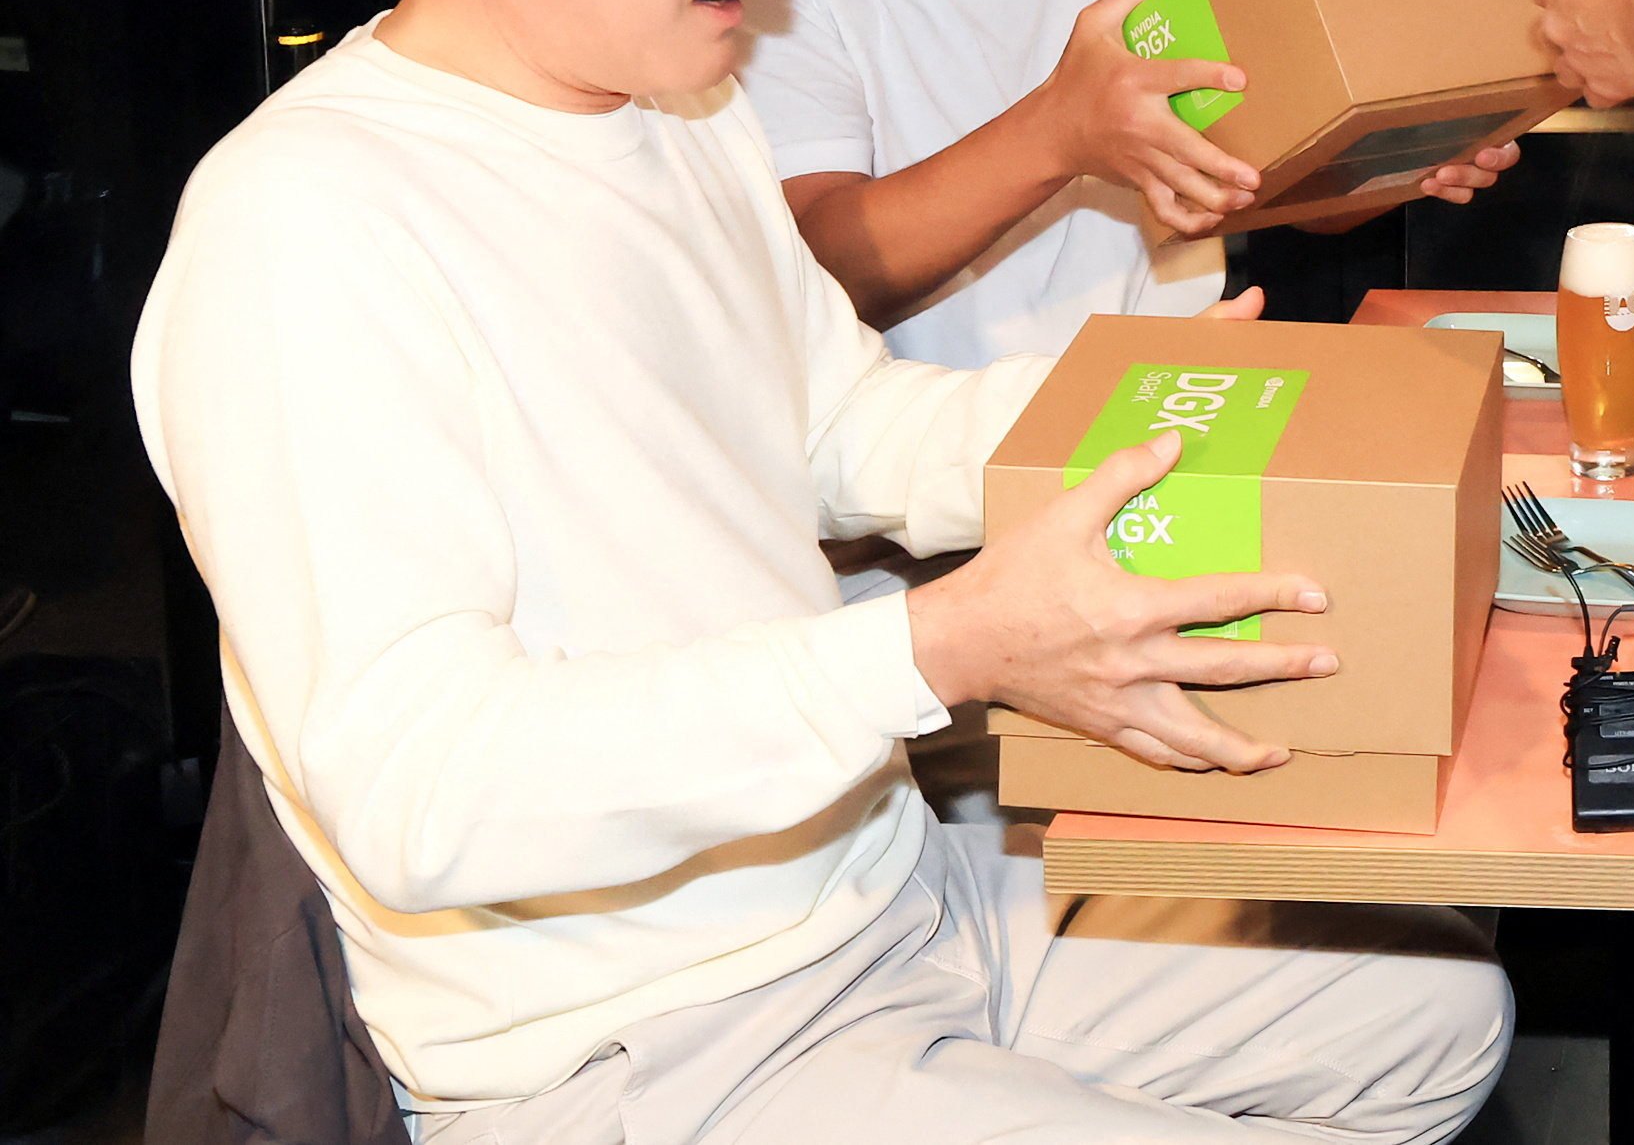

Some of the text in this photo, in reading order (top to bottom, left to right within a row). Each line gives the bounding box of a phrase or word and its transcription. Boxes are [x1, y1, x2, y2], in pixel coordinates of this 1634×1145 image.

[1129, 10, 1162, 41] NVIDIA
[1135, 19, 1176, 60] DGX
[1131, 371, 1172, 403] Spark
[1148, 372, 1238, 433] DGX
[1124, 495, 1160, 511] DIA
[1106, 513, 1174, 544] GX
[1111, 546, 1135, 559] ark
